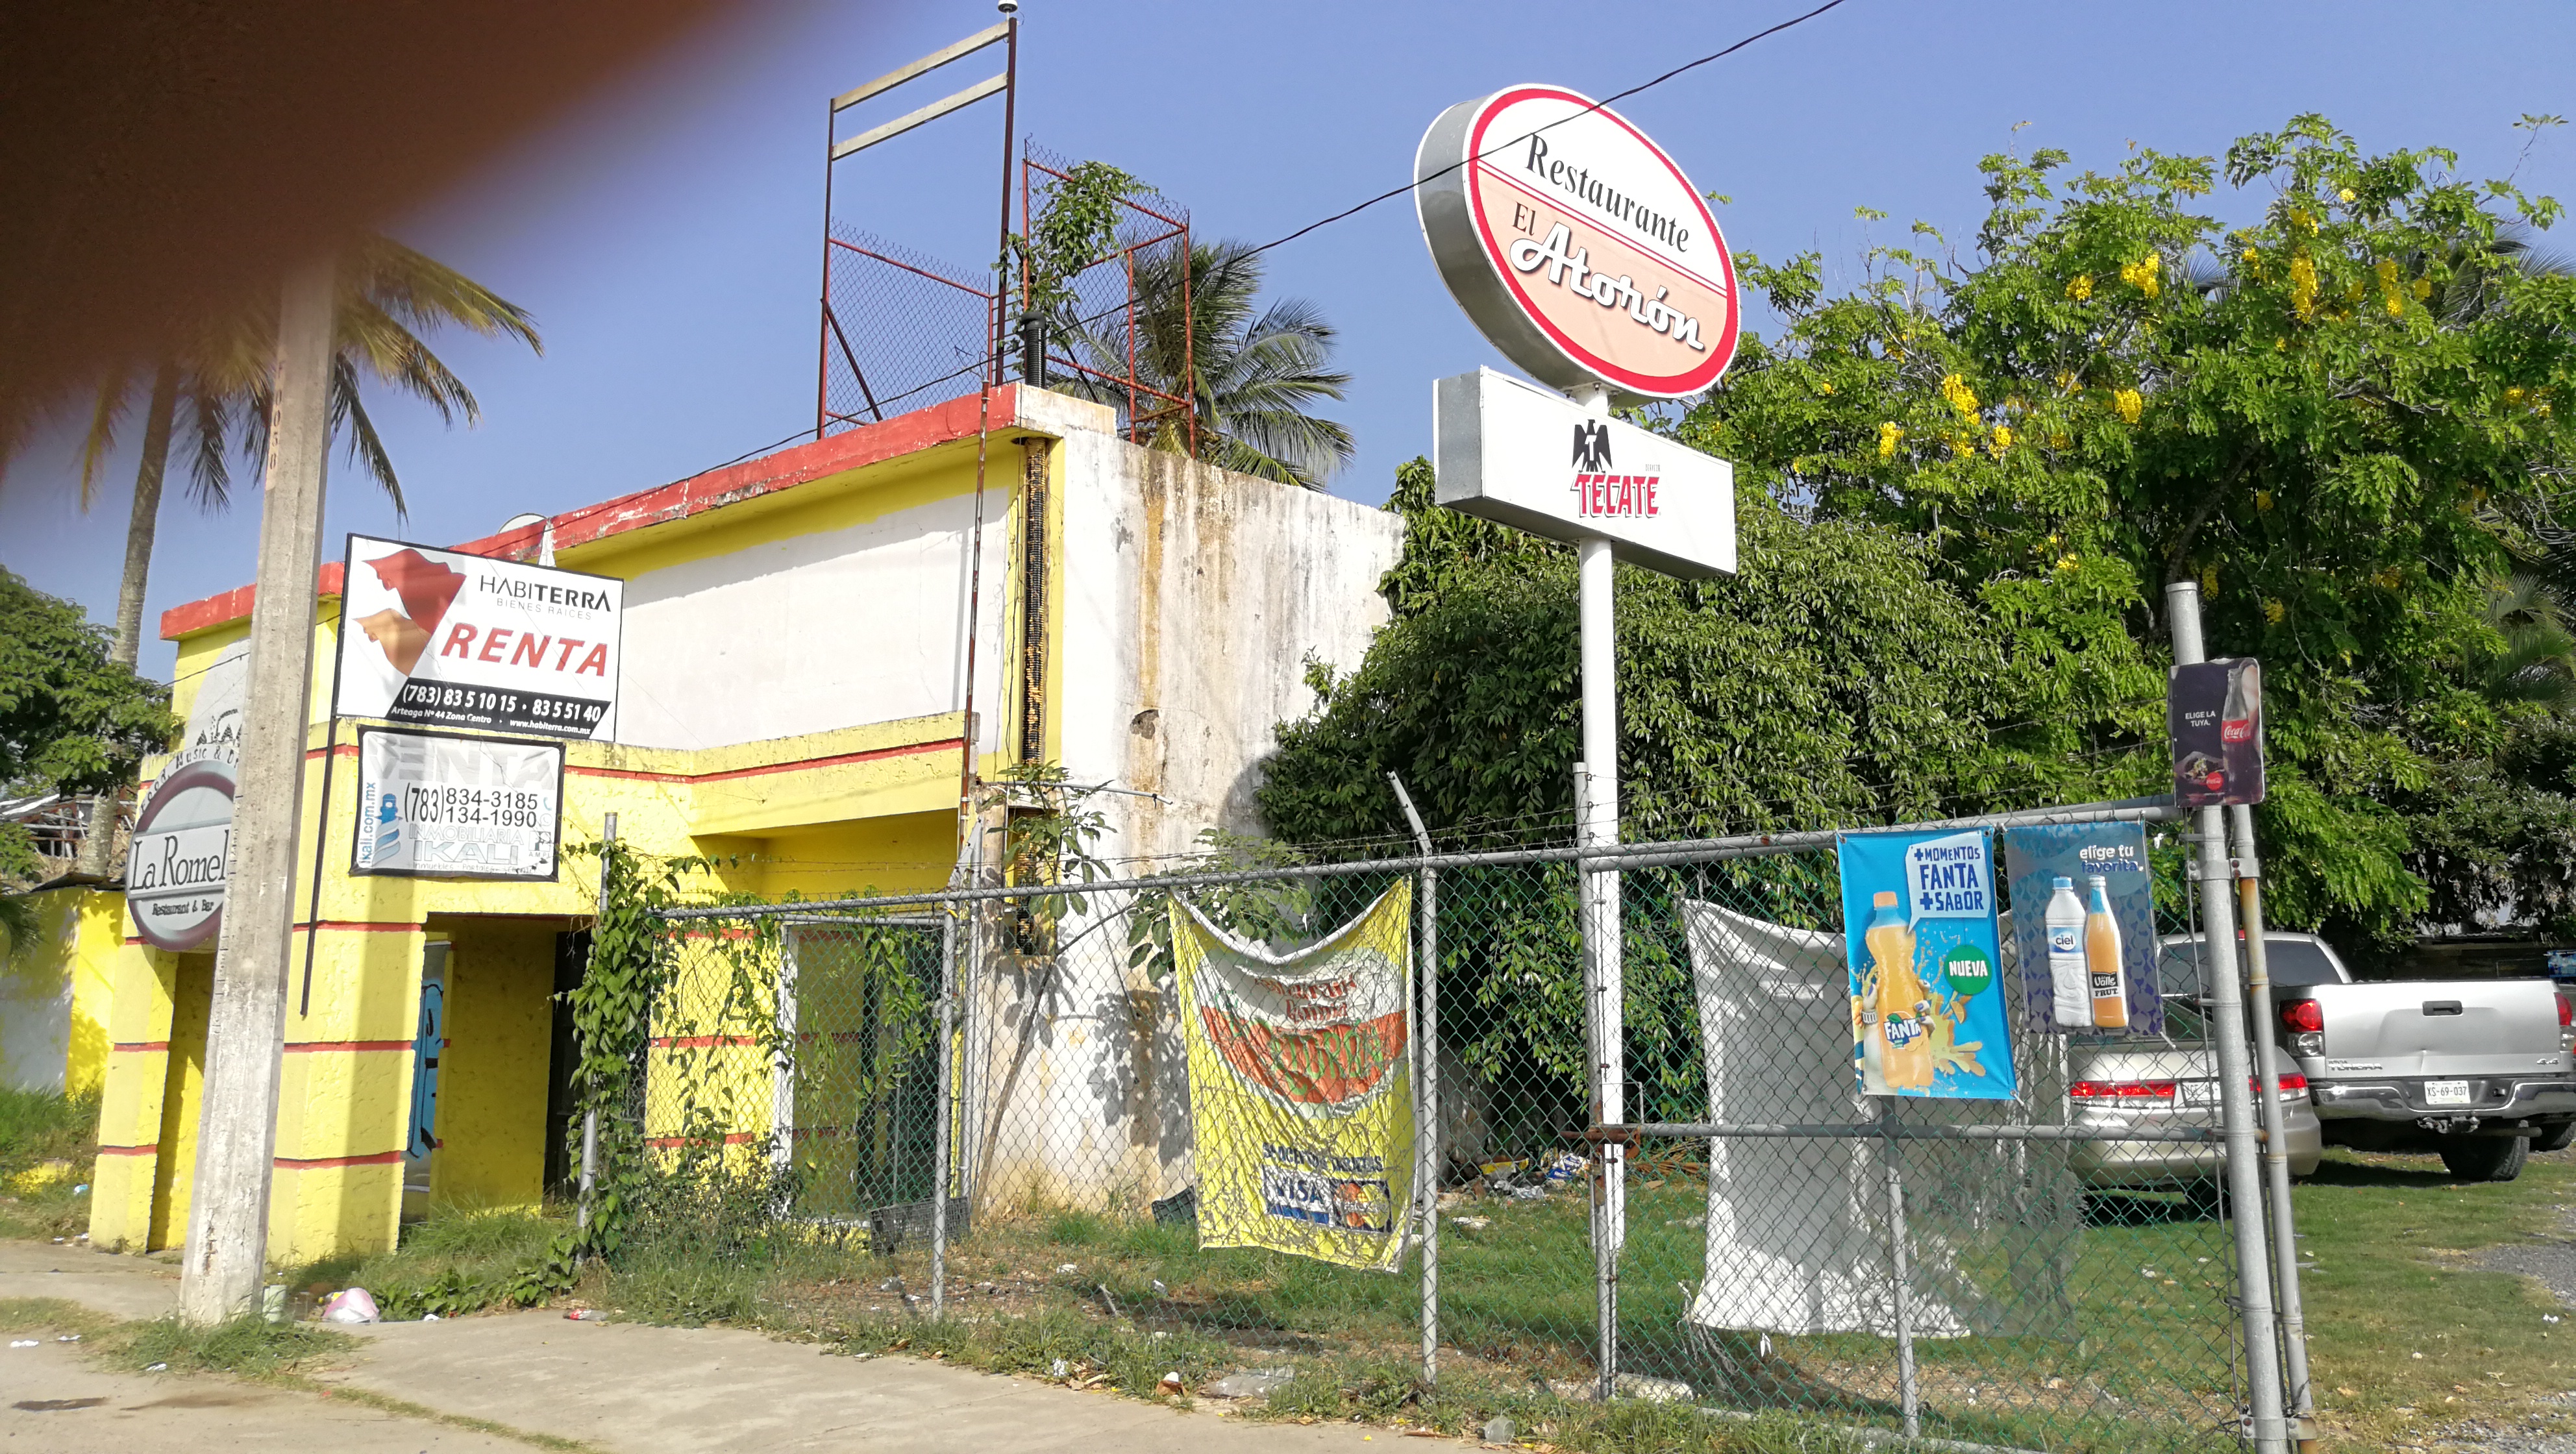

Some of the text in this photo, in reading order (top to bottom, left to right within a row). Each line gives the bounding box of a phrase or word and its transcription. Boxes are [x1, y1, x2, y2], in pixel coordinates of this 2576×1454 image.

[1524, 132, 1689, 253] Restaurante
[1512, 201, 1536, 236] El
[1509, 221, 1705, 351] Atorón
[1570, 474, 1660, 519] TECATE
[480, 575, 611, 612] HABITERRA
[497, 598, 592, 621] BIENES RAICES
[440, 621, 608, 677] RENTA
[403, 684, 441, 706] (783)
[391, 706, 425, 718] Arteaga
[445, 711, 465, 721] Zona
[466, 713, 492, 724] Centro
[510, 719, 591, 735] www.habiterra.com.mx
[446, 787, 538, 810] 834-3185
[445, 806, 537, 828] 134-1990
[409, 823, 525, 846] INMOBILIARIA
[414, 840, 519, 866] IKALI
[2079, 844, 2135, 860] elige tu
[130, 841, 156, 891] La
[1920, 863, 1979, 890] FANTA
[152, 900, 190, 916] Restaurant
[201, 899, 214, 912] Bar
[2055, 935, 2074, 945] ciel
[1948, 959, 1988, 978] NUEVA
[2094, 976, 2116, 987] Valle
[1884, 1019, 1922, 1040] FANTA
[2427, 1085, 2467, 1097] XS-69-037
